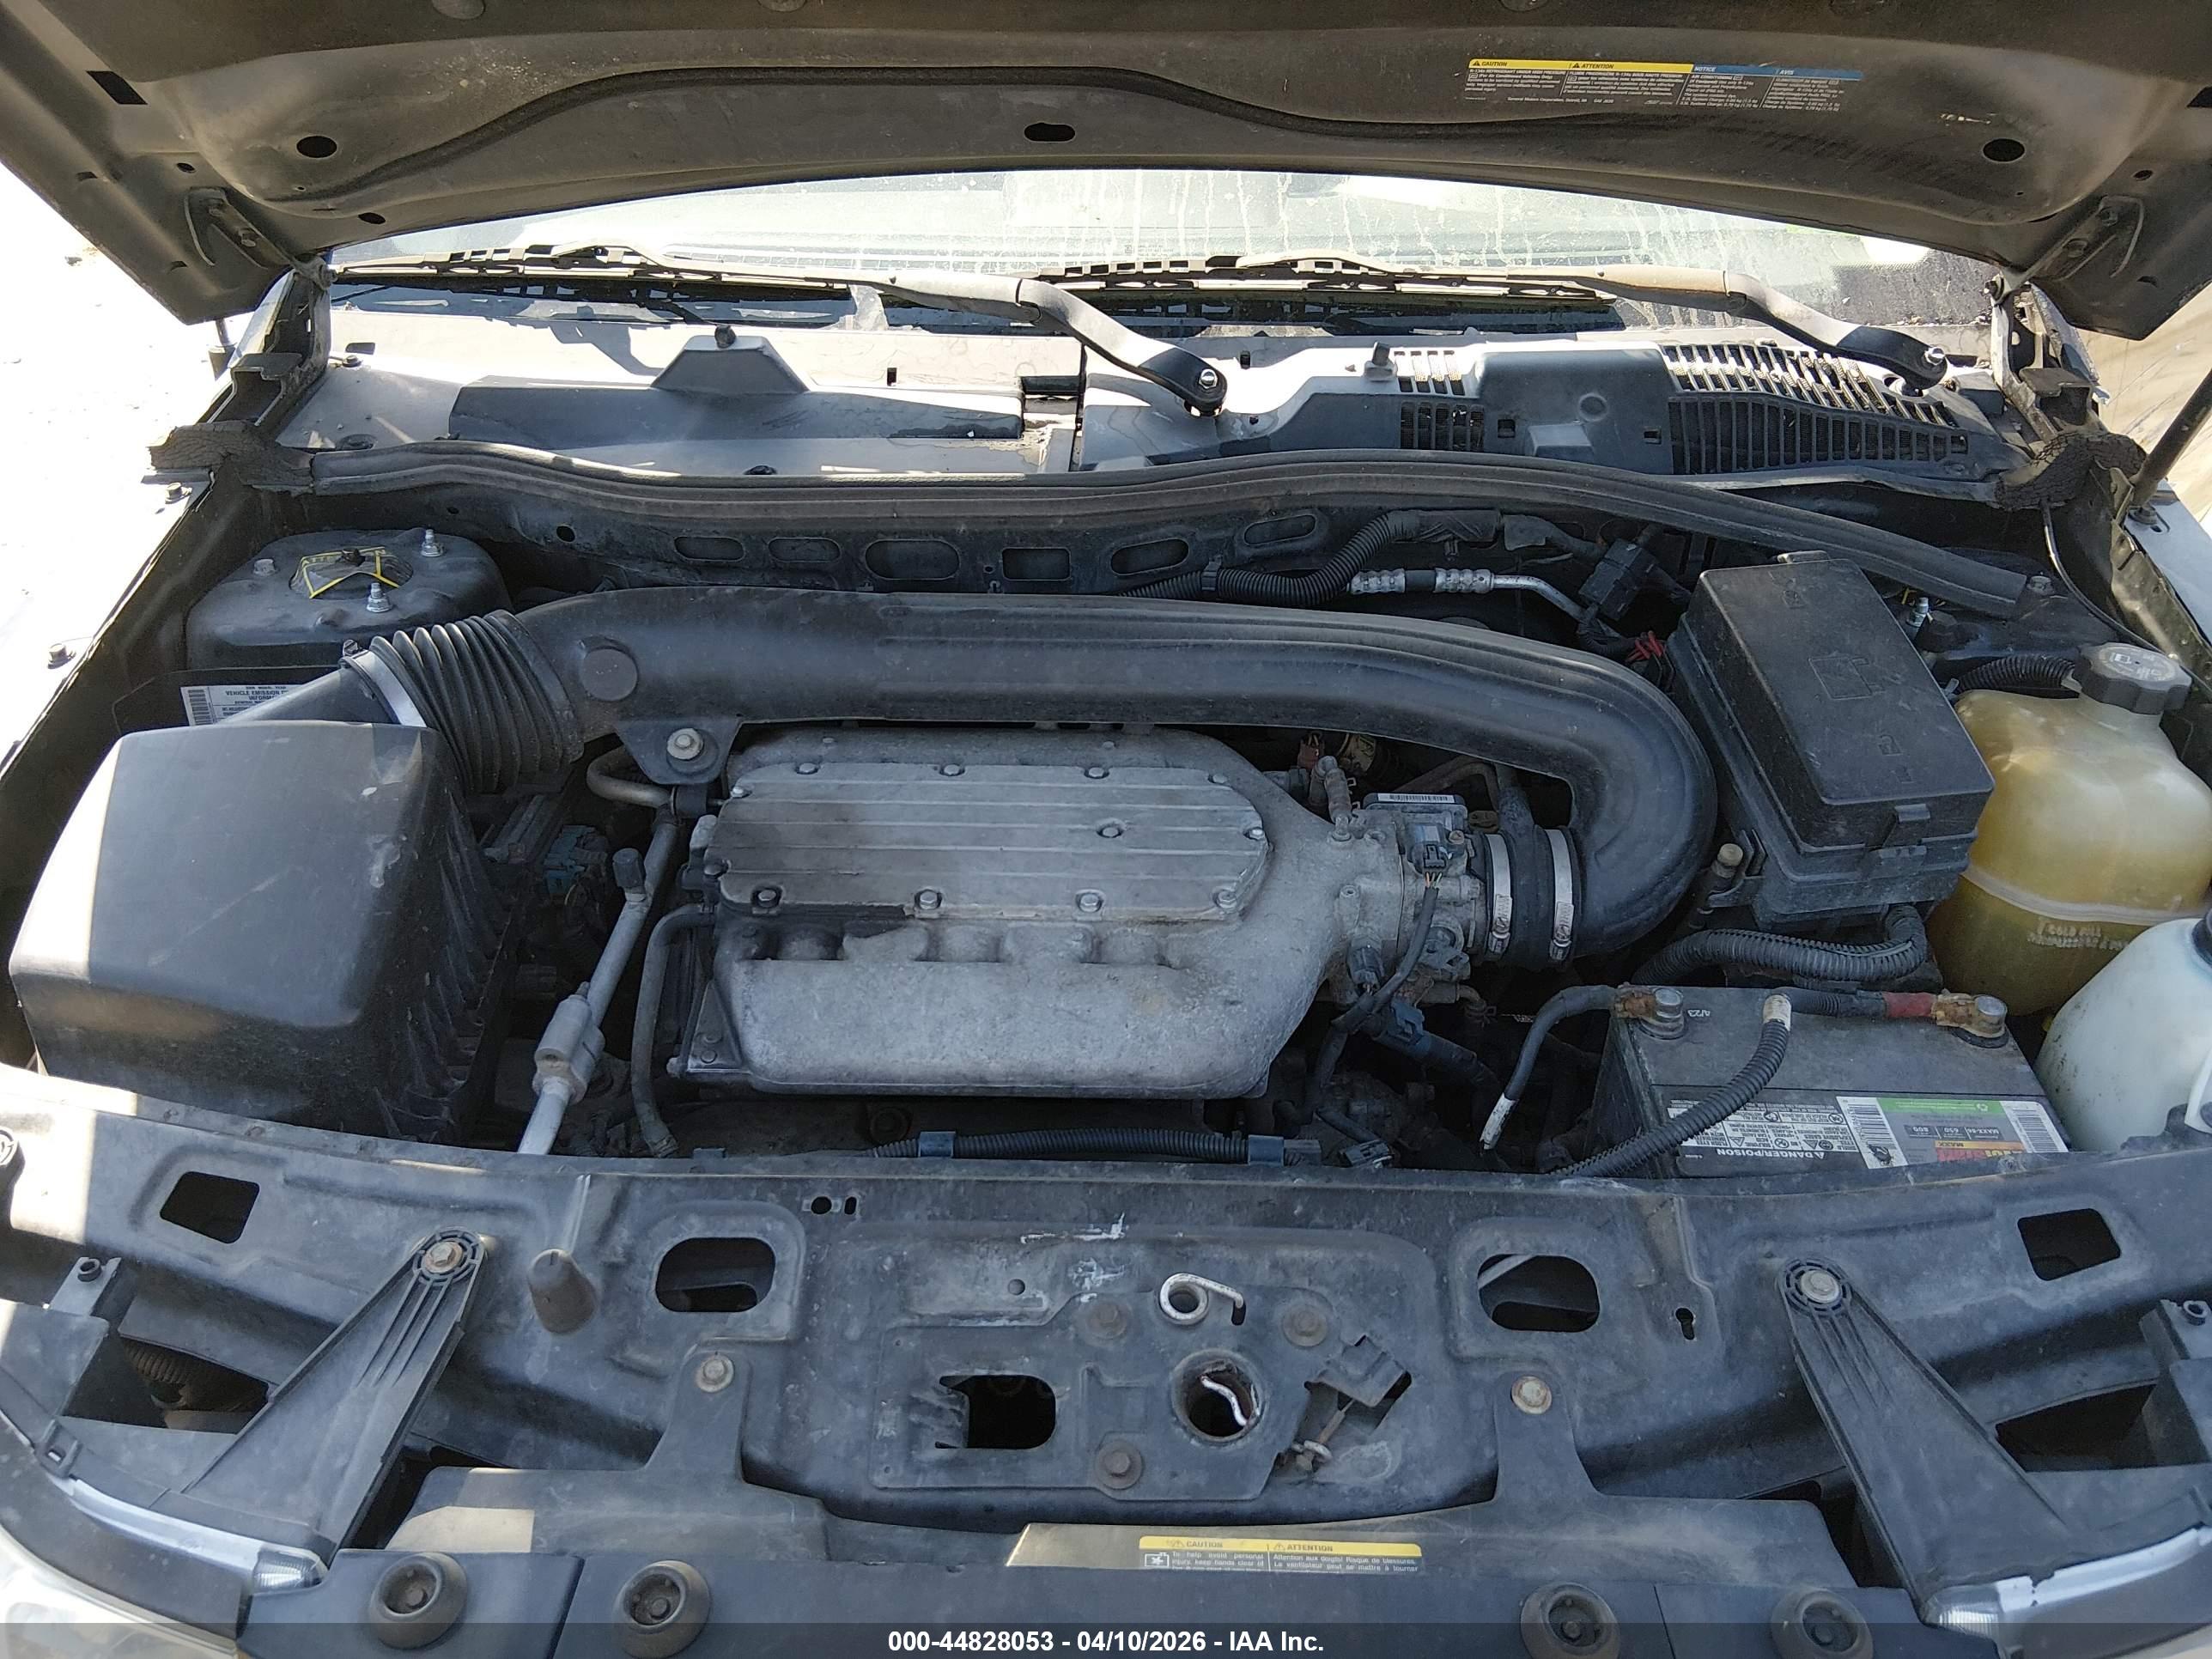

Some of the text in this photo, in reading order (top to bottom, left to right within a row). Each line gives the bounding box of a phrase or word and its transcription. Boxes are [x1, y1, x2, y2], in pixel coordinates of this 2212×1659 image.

[1687, 1009, 1711, 1018] 4/23
[1717, 1148, 1814, 1158] DANGER/POISON
[1286, 1543, 1333, 1552] ATTENTION
